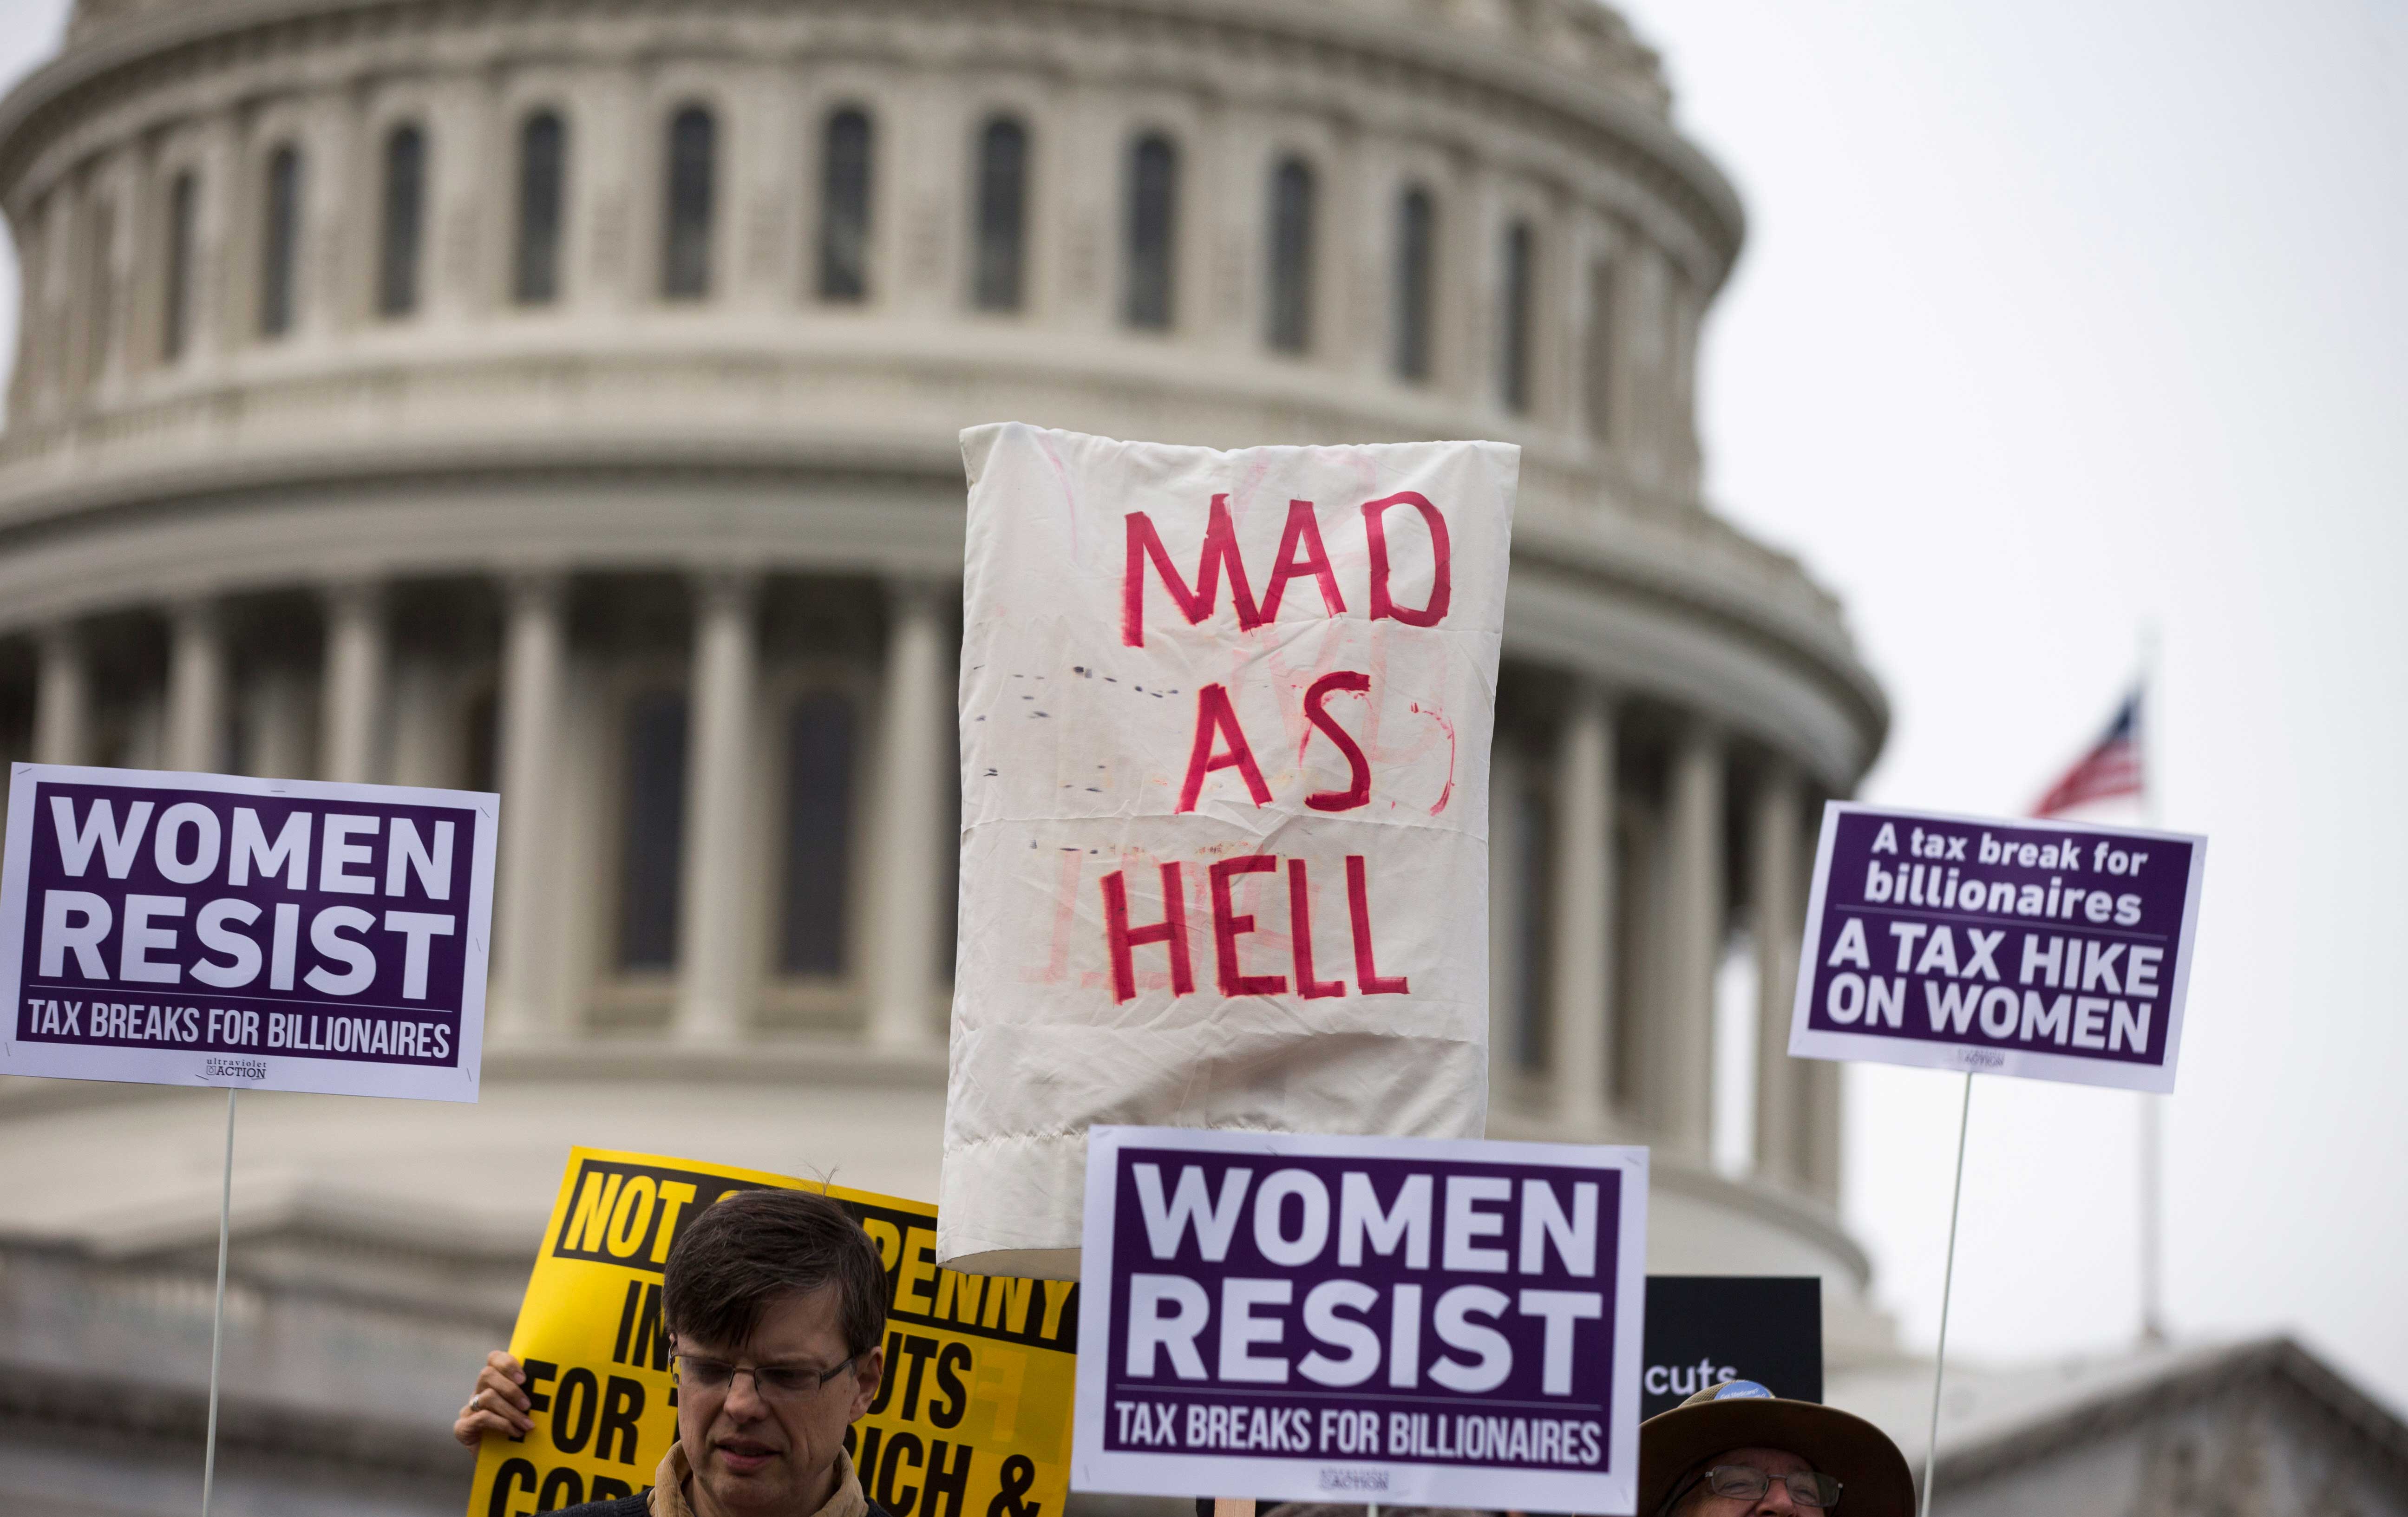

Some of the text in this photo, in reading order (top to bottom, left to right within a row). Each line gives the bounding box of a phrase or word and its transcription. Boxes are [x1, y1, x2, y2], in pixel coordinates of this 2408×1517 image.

[1122, 490, 1452, 648] MAD
[1175, 670, 1372, 815] AS
[50, 797, 455, 900] WOMEN
[1864, 860, 2142, 926] billionaires
[1871, 822, 2148, 877] A tax break for
[39, 889, 455, 1000] RESIST
[1100, 855, 1411, 1005] HELL
[1826, 917, 2164, 999] A TAX HIKE
[28, 999, 450, 1058] TAX BREAKS FOR BILLIONAIRES
[1826, 972, 2152, 1054] ON WOMEN
[206, 1058, 267, 1068] ultraviolet
[216, 1066, 266, 1078] ACTION
[563, 1171, 697, 1264] NOT
[1132, 1163, 1598, 1277] WOMEN
[866, 1331, 972, 1429] UTS
[1125, 1273, 1603, 1396] RESIST
[1645, 1357, 1738, 1395] cuts
[509, 1358, 645, 1465] FOR
[1115, 1402, 1601, 1465] TAX BREAKS FOR BILLIONAIRES
